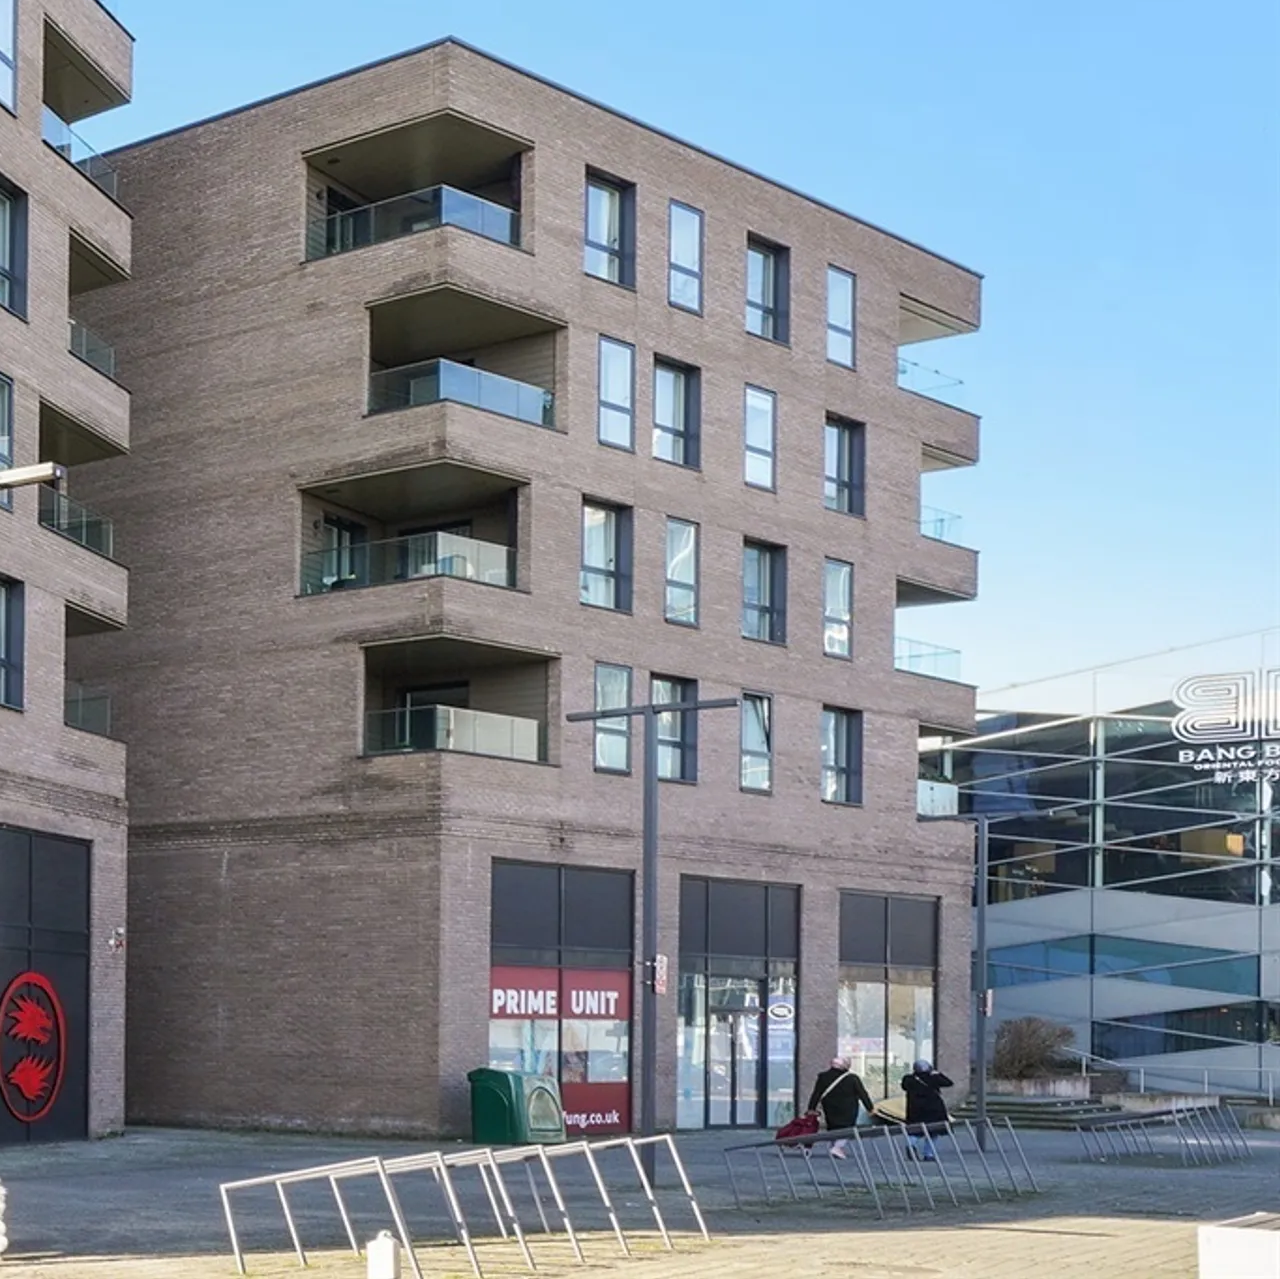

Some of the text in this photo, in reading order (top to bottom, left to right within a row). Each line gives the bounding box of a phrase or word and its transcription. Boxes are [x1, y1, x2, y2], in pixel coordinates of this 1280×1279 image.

[1179, 745, 1257, 763] BANG
[492, 988, 619, 1015] PRIME UNIT
